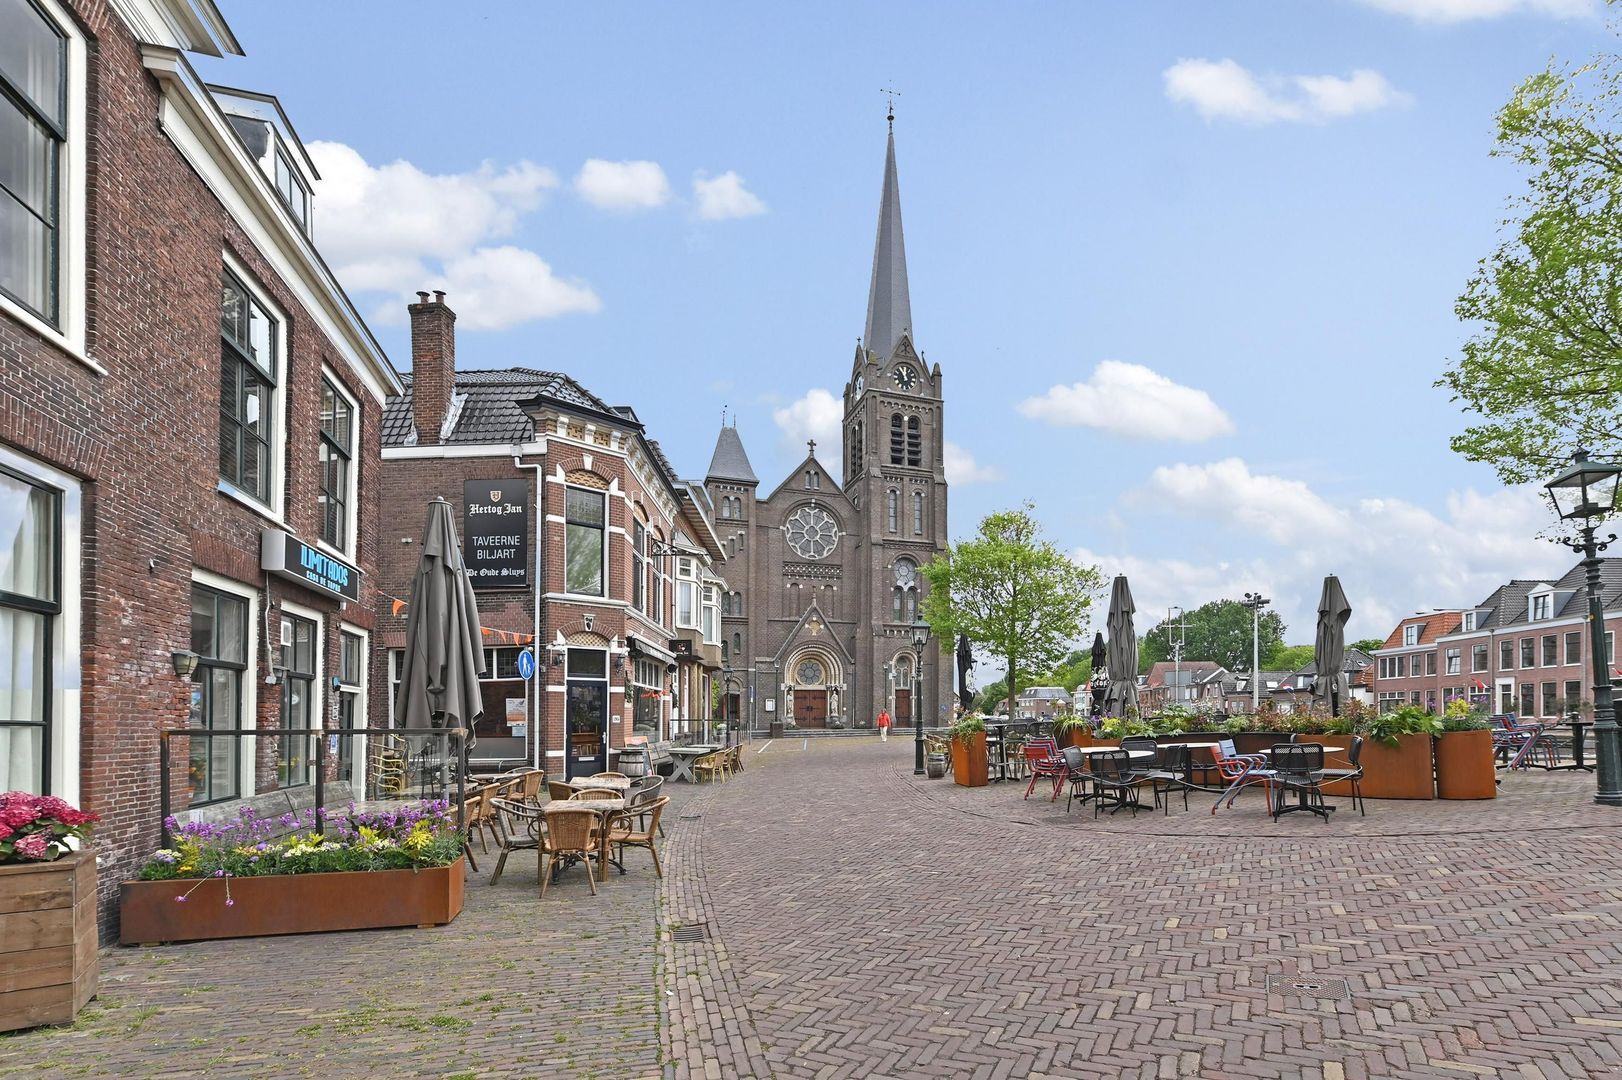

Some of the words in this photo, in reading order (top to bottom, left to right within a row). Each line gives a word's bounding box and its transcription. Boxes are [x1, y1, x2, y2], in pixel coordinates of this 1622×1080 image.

[469, 503, 502, 517] Hertog
[503, 503, 522, 516] Jan
[472, 535, 520, 546] TAVEERNE
[477, 549, 516, 560] BILJART
[479, 568, 499, 577] Oude
[501, 567, 525, 578] Sluys
[306, 570, 319, 583] CASA
[320, 577, 326, 587] DE
